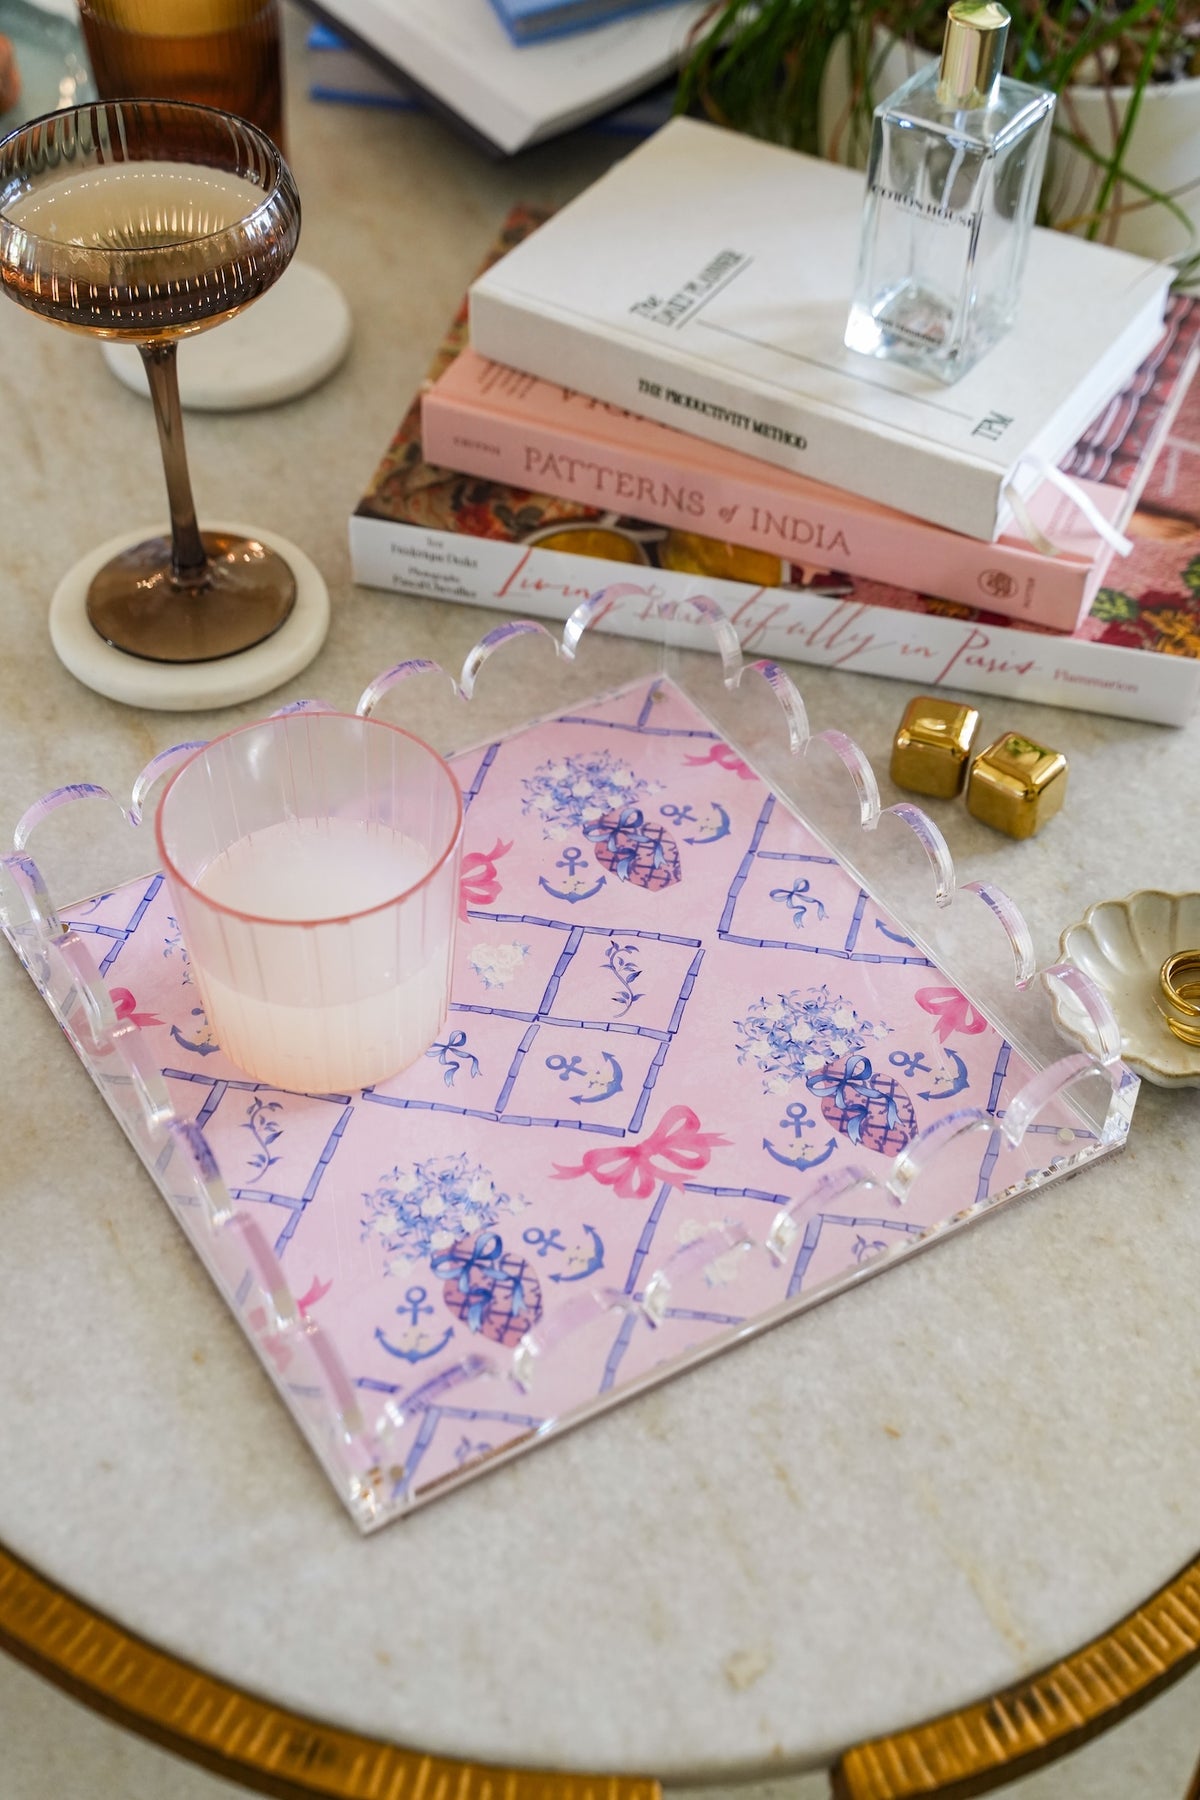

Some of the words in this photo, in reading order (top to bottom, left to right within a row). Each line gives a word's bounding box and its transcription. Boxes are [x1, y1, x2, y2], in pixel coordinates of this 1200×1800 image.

[638, 377, 662, 398] THE
[665, 387, 751, 431] PRODUCTIVITY
[752, 419, 808, 451] METHOD
[523, 446, 706, 518] PATTERNS
[717, 503, 740, 525] of
[751, 506, 852, 556] INDIA
[901, 639, 939, 660] in
[932, 627, 1041, 685] Paris
